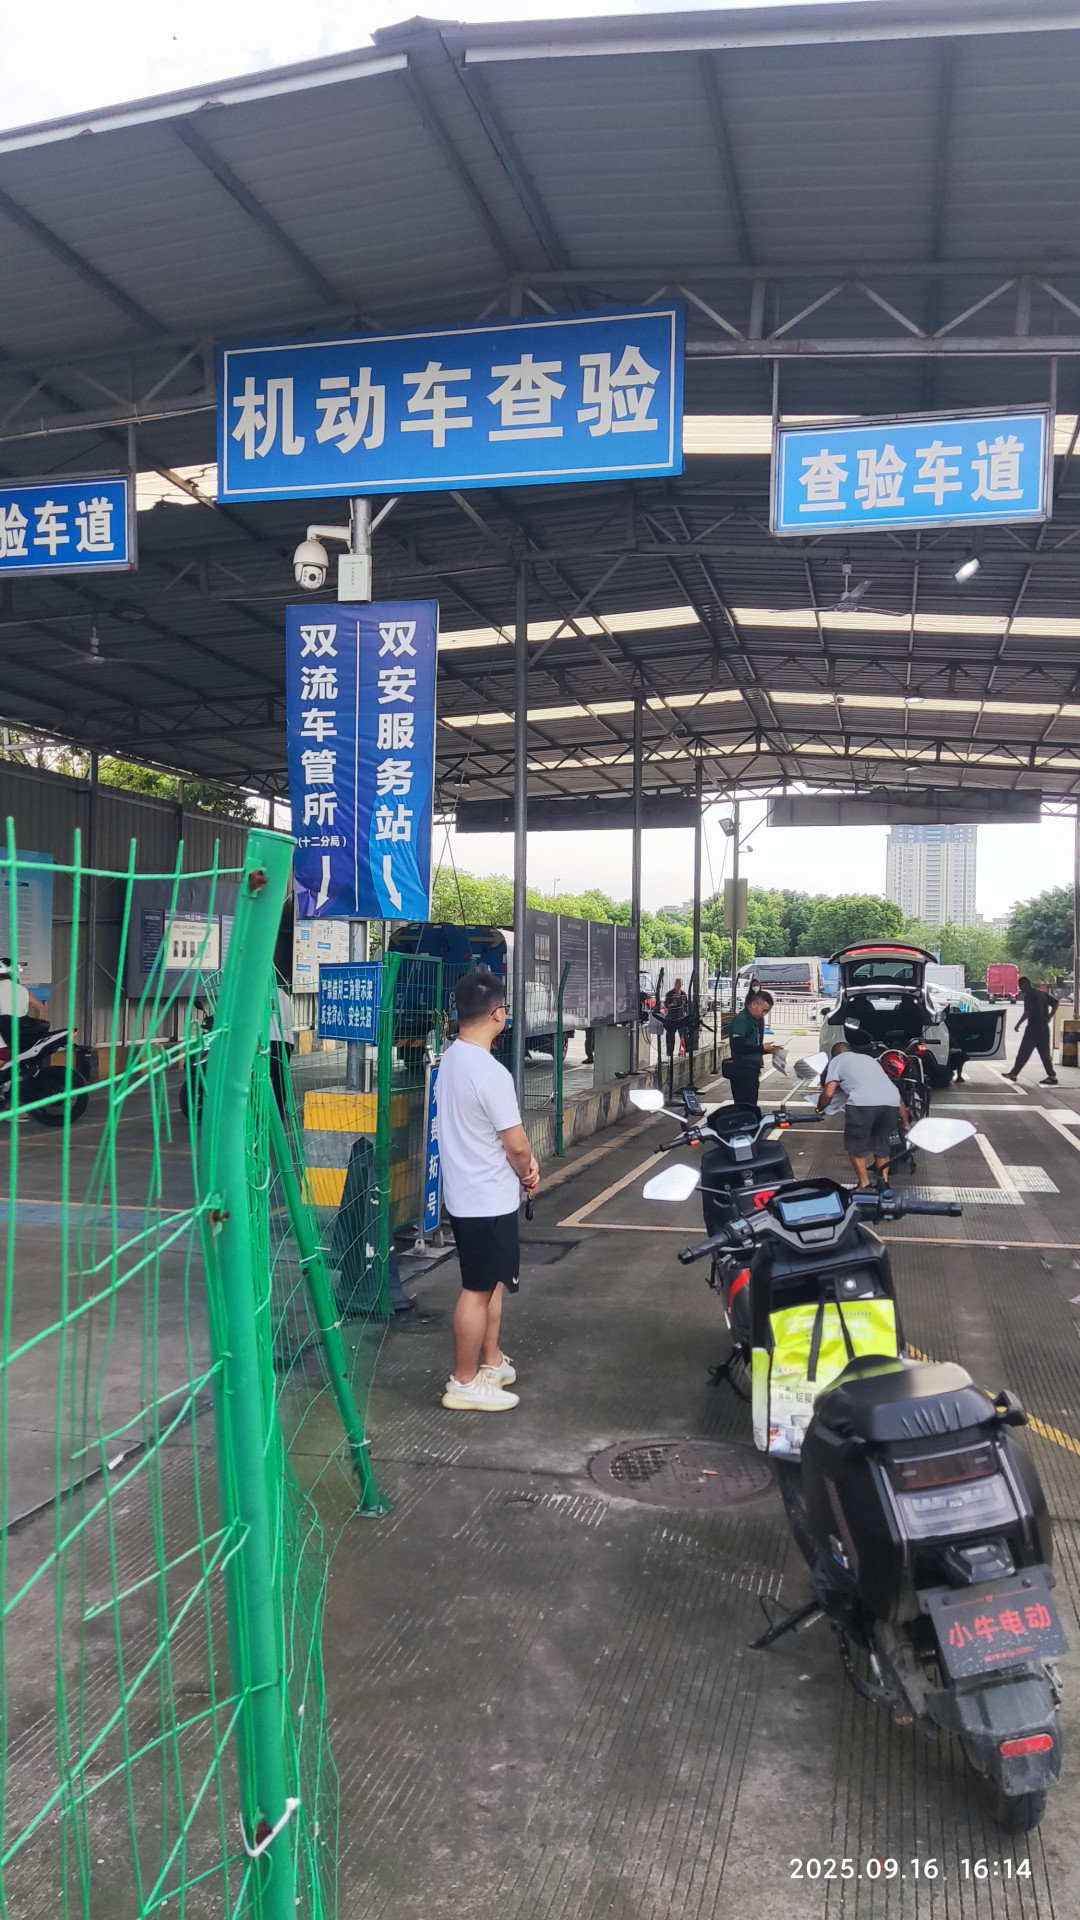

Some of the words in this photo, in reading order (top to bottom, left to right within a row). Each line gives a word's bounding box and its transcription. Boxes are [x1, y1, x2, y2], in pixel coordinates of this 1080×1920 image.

[231, 344, 661, 460] 机动车查验
[799, 435, 1024, 512] 查验车道
[300, 624, 338, 827] 双流车管所
[375, 621, 417, 842] 双安服务站
[948, 1603, 1051, 1648] 小牛电动
